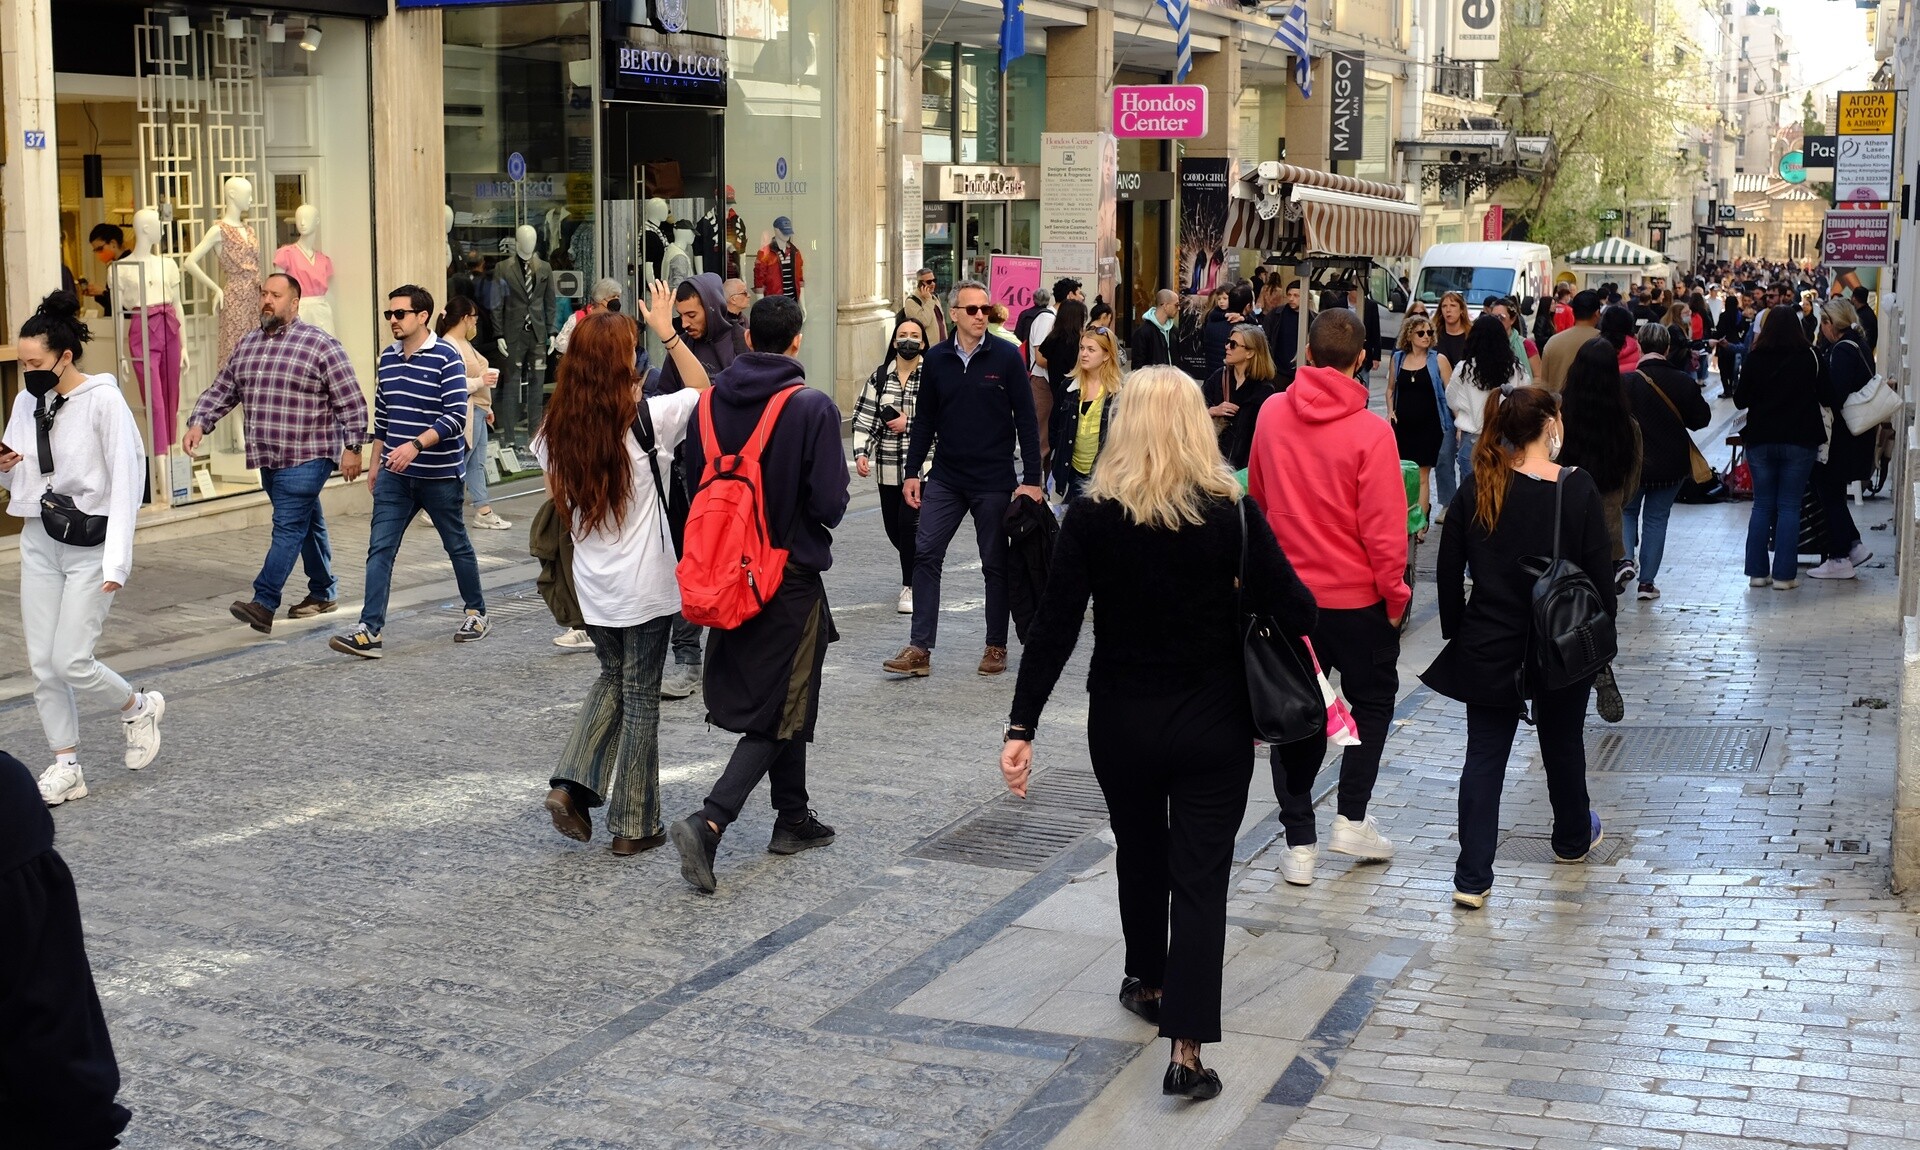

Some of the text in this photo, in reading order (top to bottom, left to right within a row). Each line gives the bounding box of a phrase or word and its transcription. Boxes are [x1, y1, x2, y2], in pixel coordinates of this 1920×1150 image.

[619, 48, 721, 77] BERTO LUCCI
[644, 77, 699, 88] MILANO
[1121, 93, 1196, 112] Hondos
[1333, 59, 1351, 151] MANGO
[1850, 95, 1885, 106] ΑΓΟΡΑ
[1845, 107, 1888, 118] ΧΡΥΣΟΥ
[1120, 112, 1188, 131] Center
[26, 132, 44, 147] 37
[1810, 142, 1836, 157] Pas
[1117, 173, 1140, 189] ANGO
[1183, 173, 1227, 182] GOOD GIRL
[754, 182, 807, 193] BERTO LUCCI
[1719, 206, 1735, 217] 10
[1488, 206, 1496, 241] chillbox
[1828, 219, 1887, 228] ΕΠΙΔΙΟΡΘΩΣΕΙΣ
[1855, 229, 1887, 238] ρούχων
[1826, 242, 1885, 253] e-paramana
